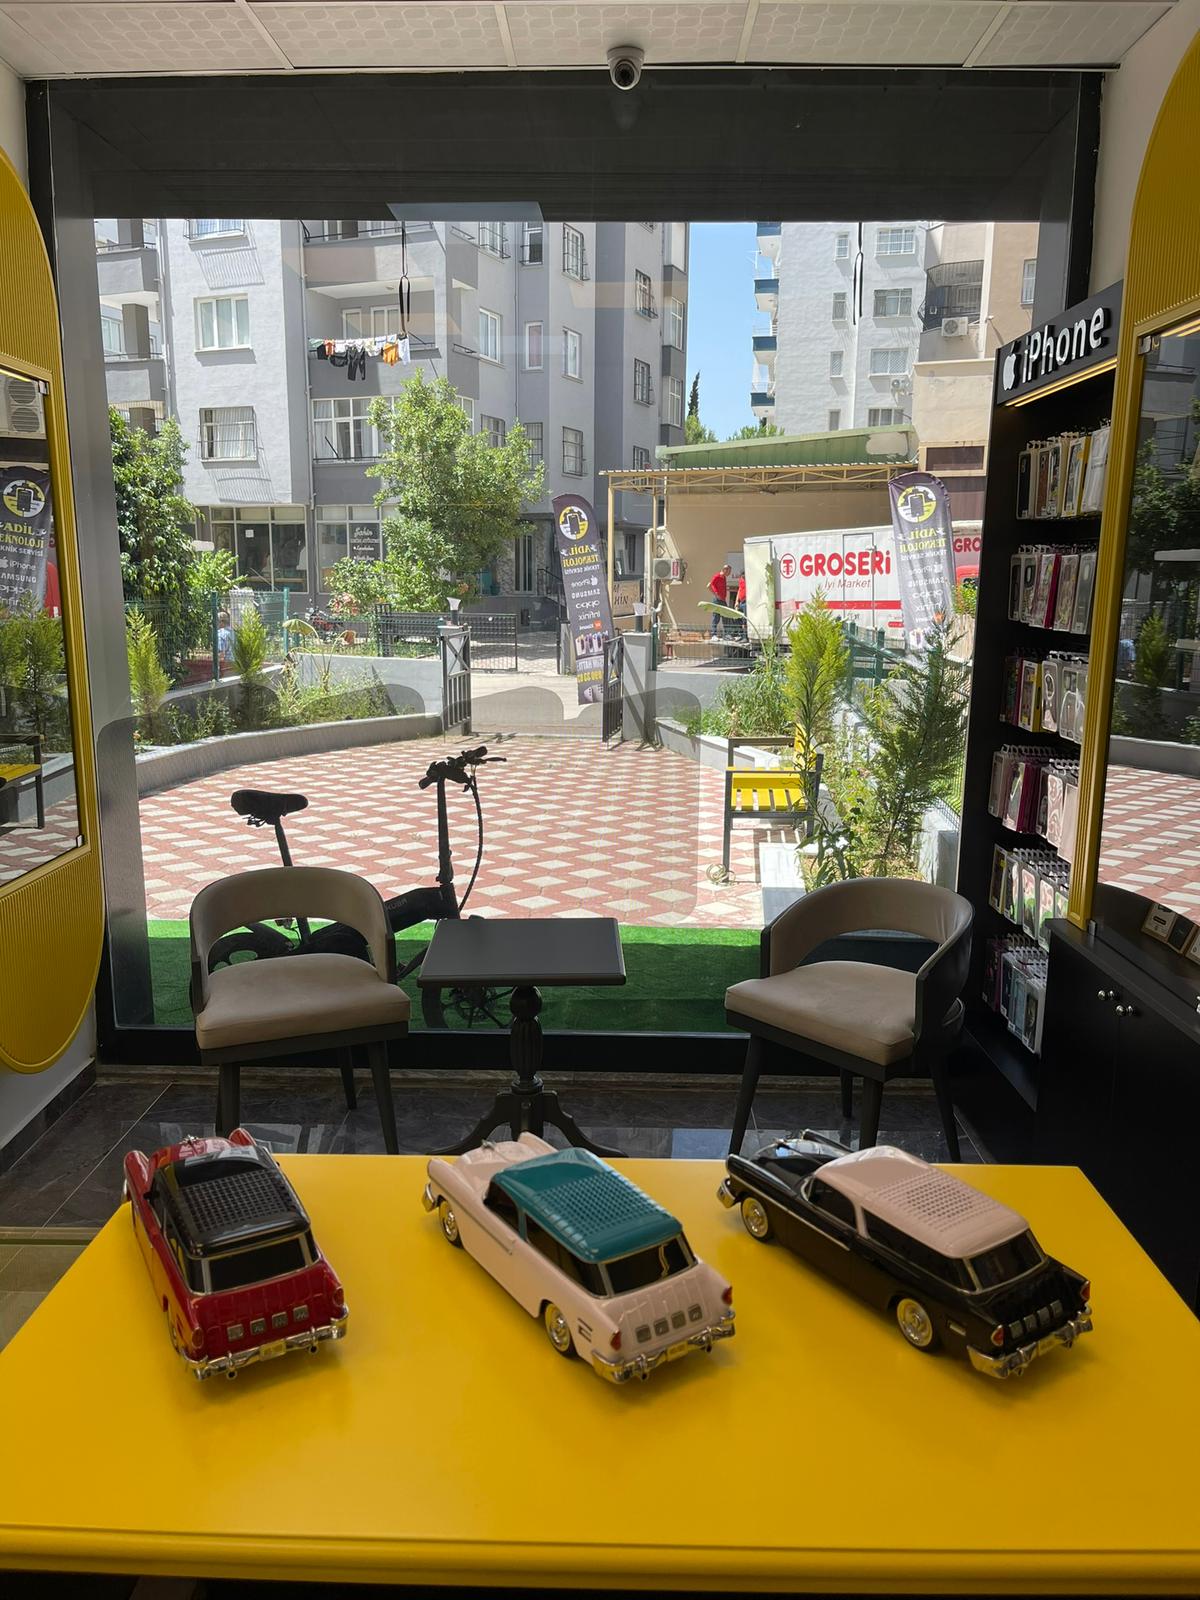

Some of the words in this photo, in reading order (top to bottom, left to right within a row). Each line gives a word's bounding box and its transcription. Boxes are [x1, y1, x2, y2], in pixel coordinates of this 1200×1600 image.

[1022, 307, 1105, 384] iPhone
[3, 522, 35, 536] ADİL
[0, 534, 44, 548] EKNOLOJİ
[953, 537, 981, 553] GRO
[0, 545, 18, 553] KNİK
[9, 560, 37, 570] iPhone
[1, 572, 37, 583] AMSUNG
[837, 578, 871, 588] Market
[614, 595, 629, 605] HİN
